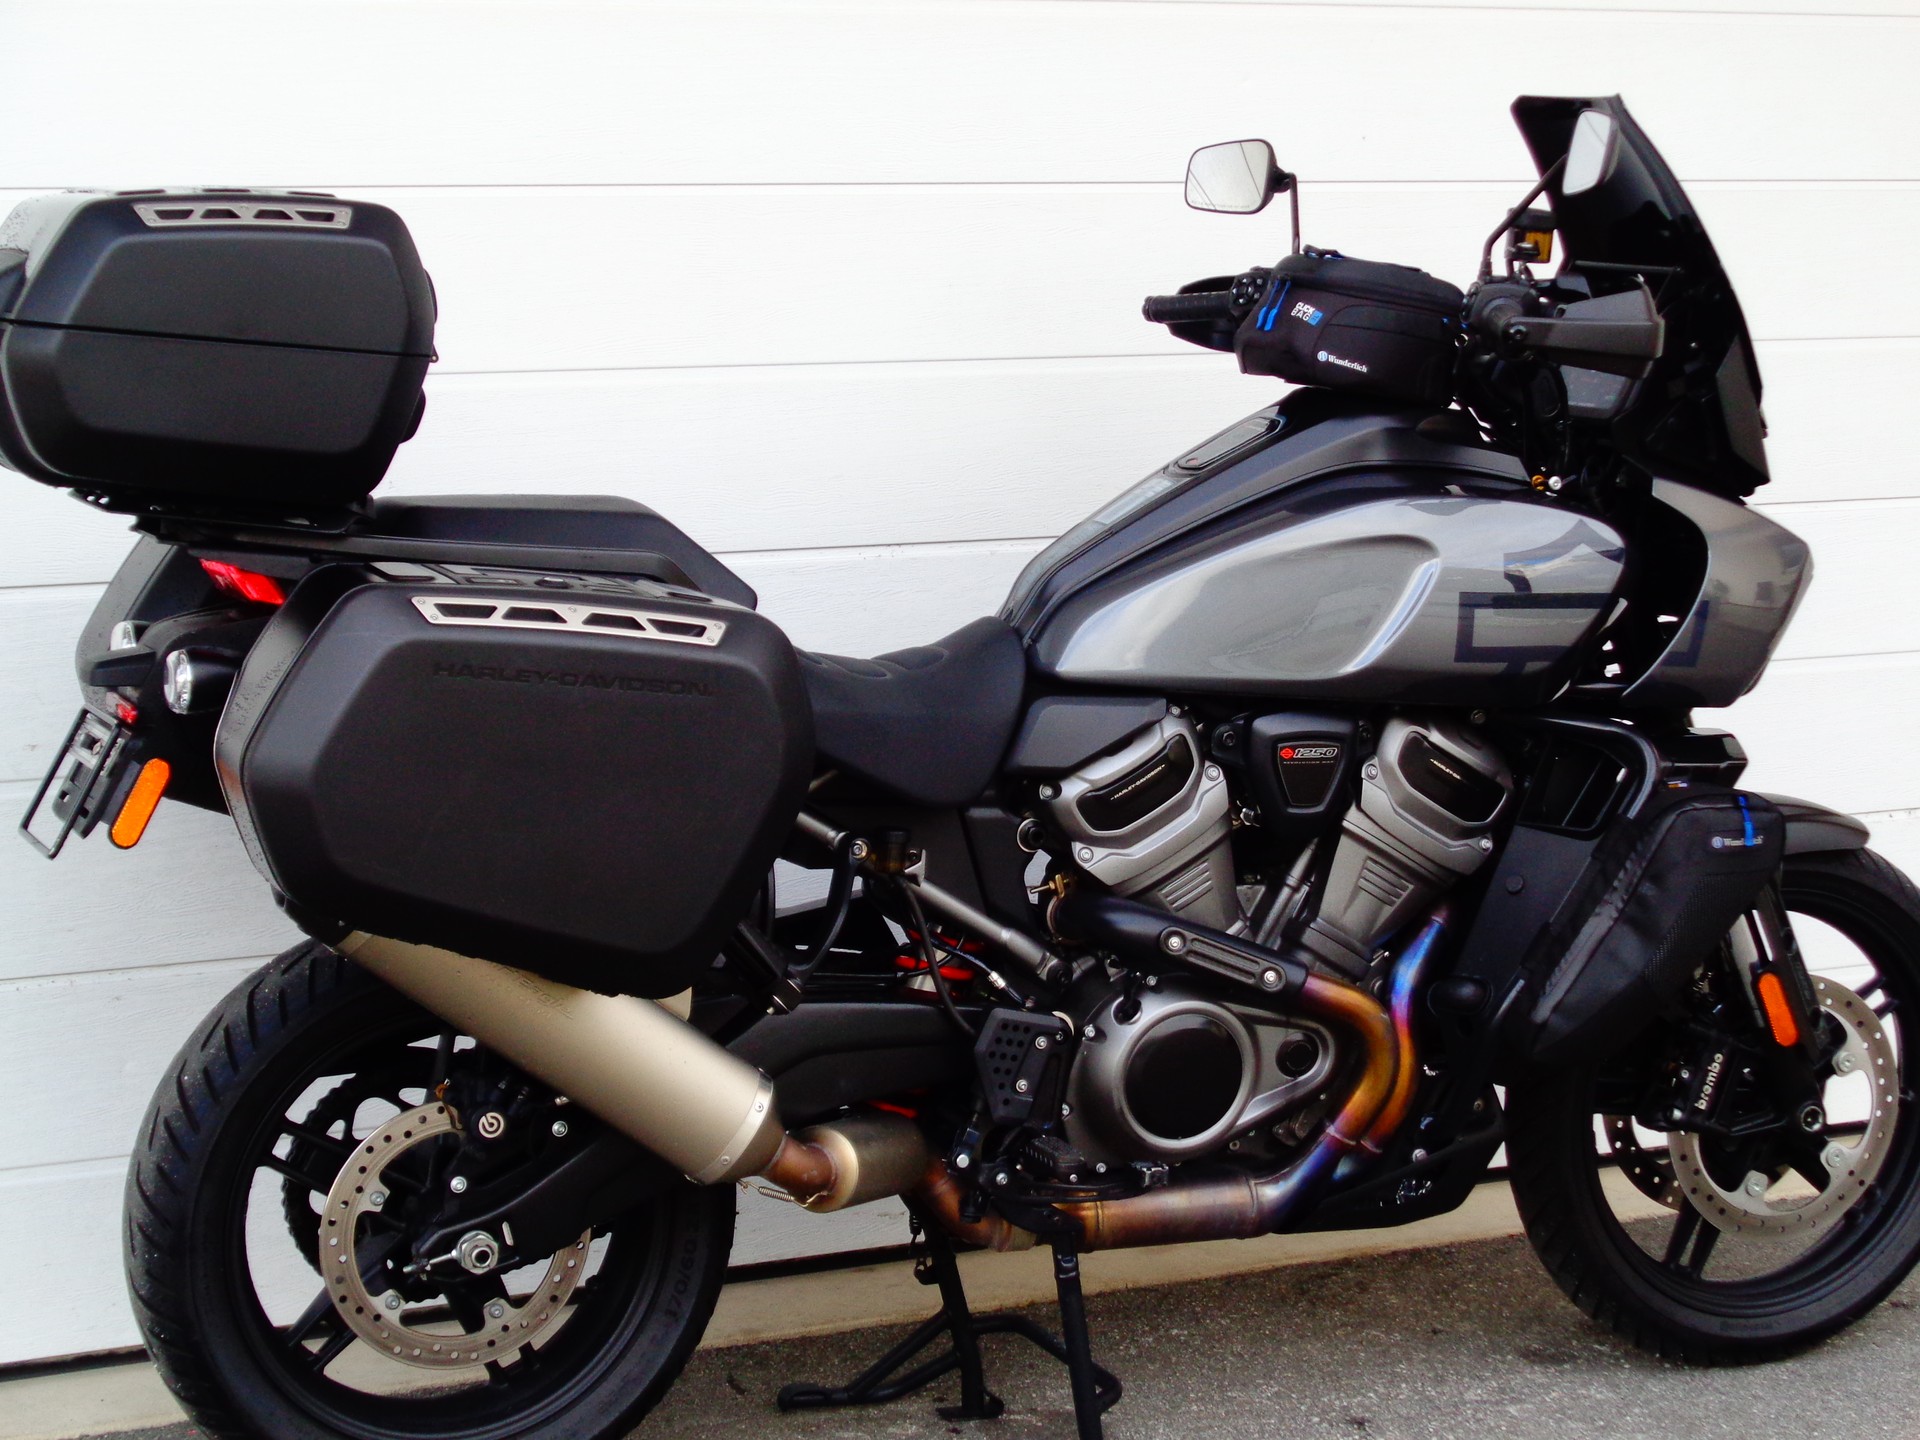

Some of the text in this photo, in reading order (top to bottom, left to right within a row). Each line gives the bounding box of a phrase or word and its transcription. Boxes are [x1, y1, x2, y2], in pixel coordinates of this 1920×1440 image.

[1290, 307, 1311, 321] BAG
[1295, 301, 1316, 315] CLICK
[1328, 354, 1368, 373] Wunderlich
[432, 661, 709, 697] HARLEY-DAVIDSON
[1293, 747, 1338, 759] 1250
[1694, 1052, 1724, 1111] brembo
